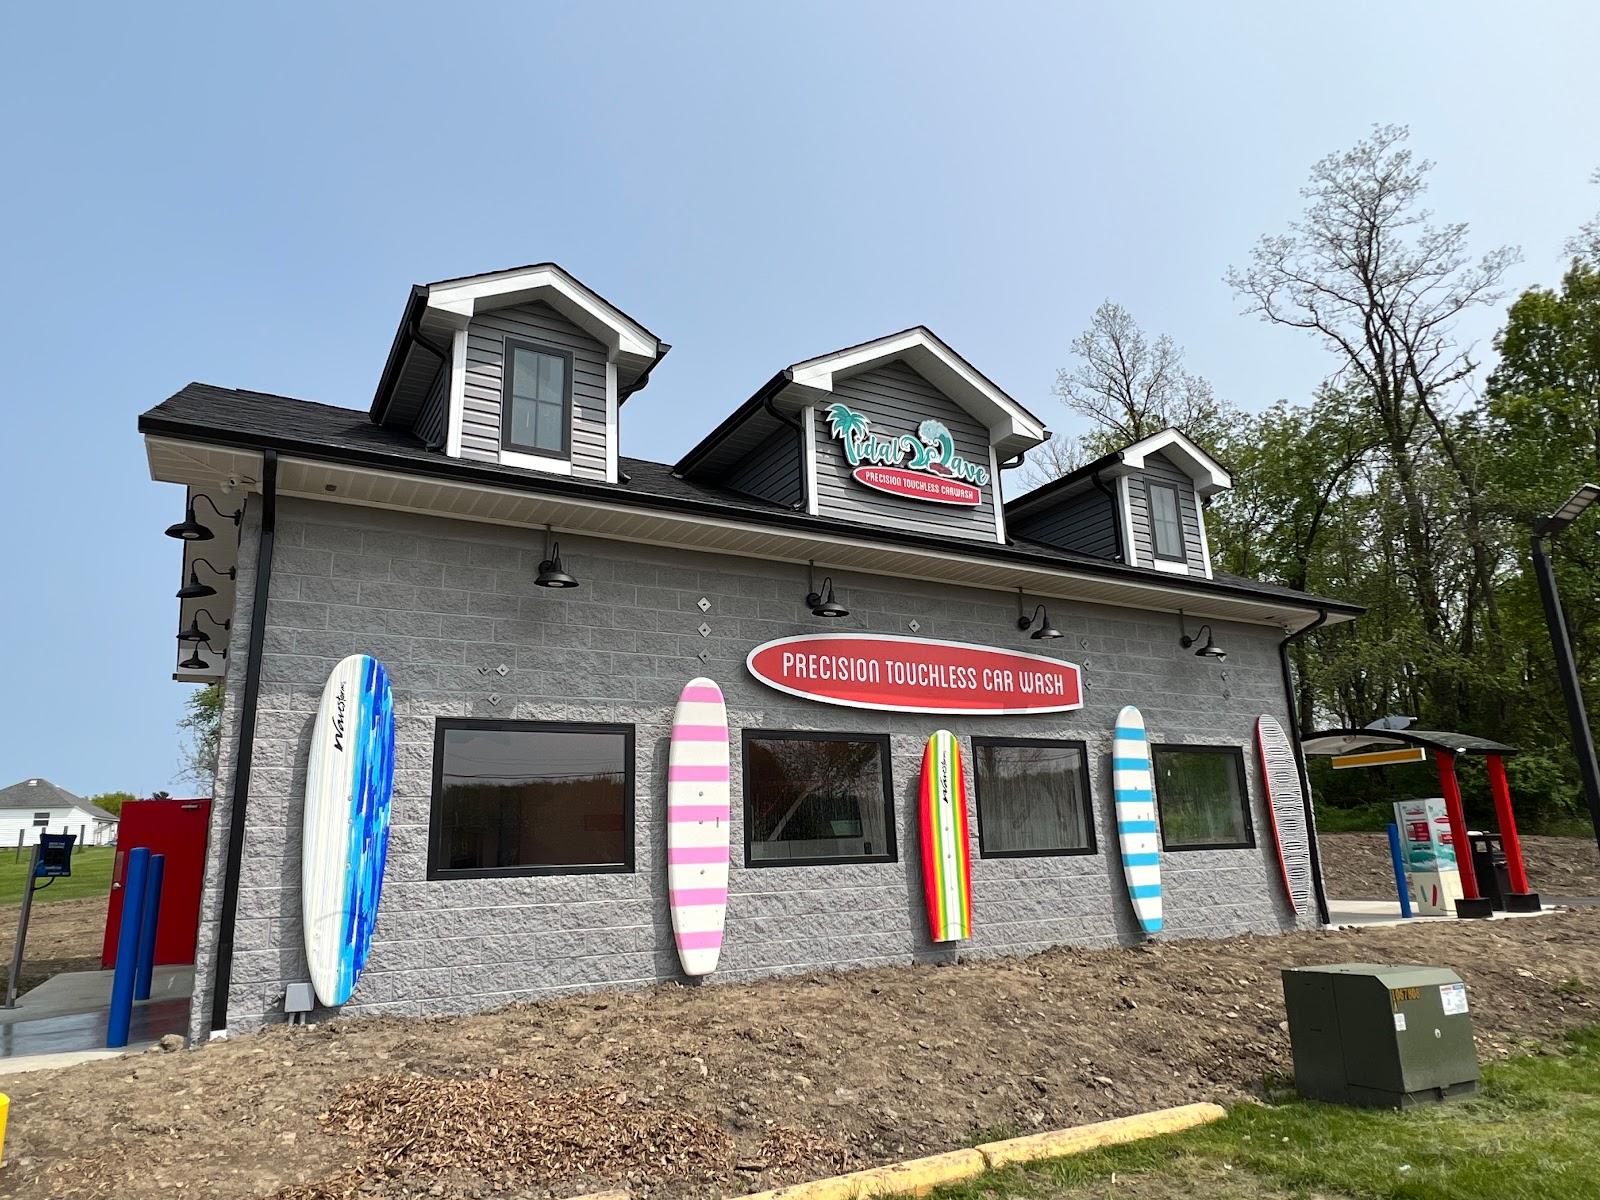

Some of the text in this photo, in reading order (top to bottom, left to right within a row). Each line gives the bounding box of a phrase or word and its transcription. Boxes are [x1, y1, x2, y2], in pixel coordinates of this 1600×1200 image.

[865, 471, 974, 500] PRECISION TOUCHLESS CARWASH
[783, 652, 1064, 696] PRECISION TOUCHLESS CAR WASH
